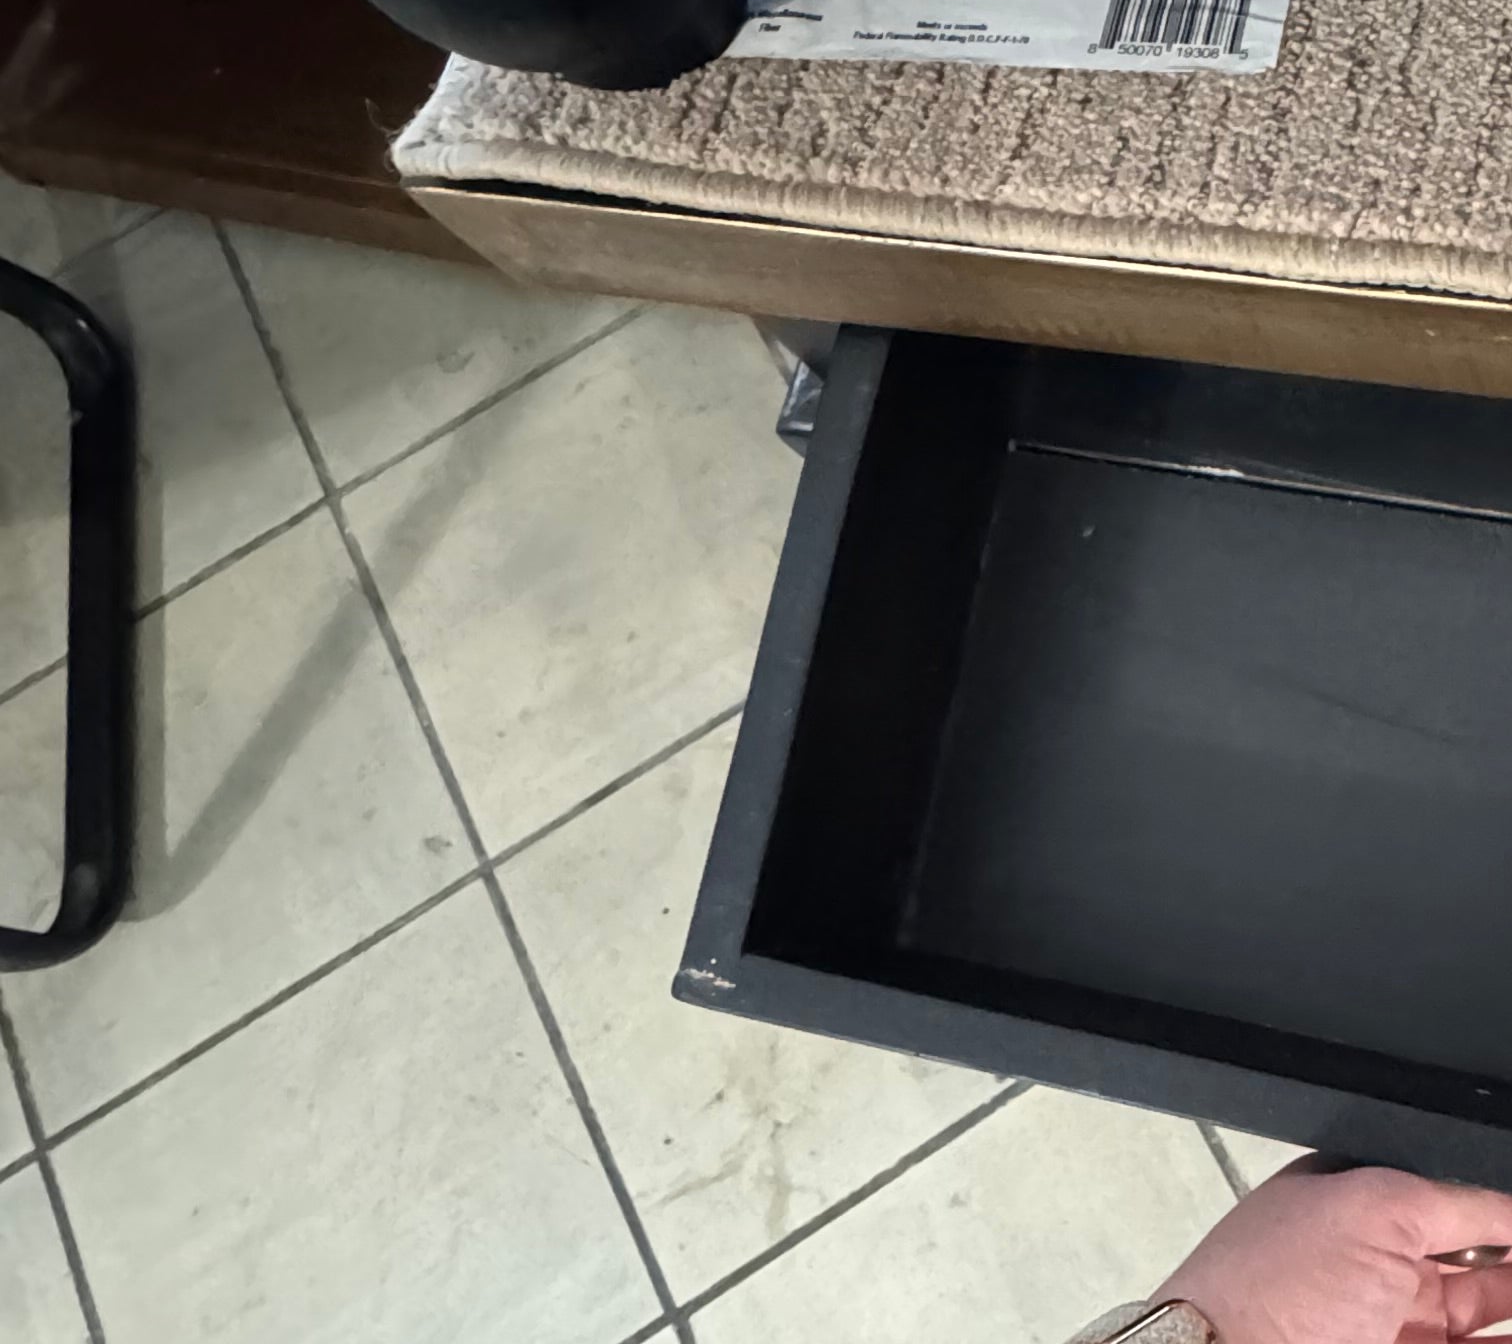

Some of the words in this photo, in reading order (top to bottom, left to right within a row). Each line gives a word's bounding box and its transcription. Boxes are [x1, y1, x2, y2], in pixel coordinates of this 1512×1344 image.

[1087, 42, 1098, 54] 8
[1117, 43, 1163, 57] 50070
[1177, 46, 1220, 60] 19308
[1239, 48, 1249, 61] 5
